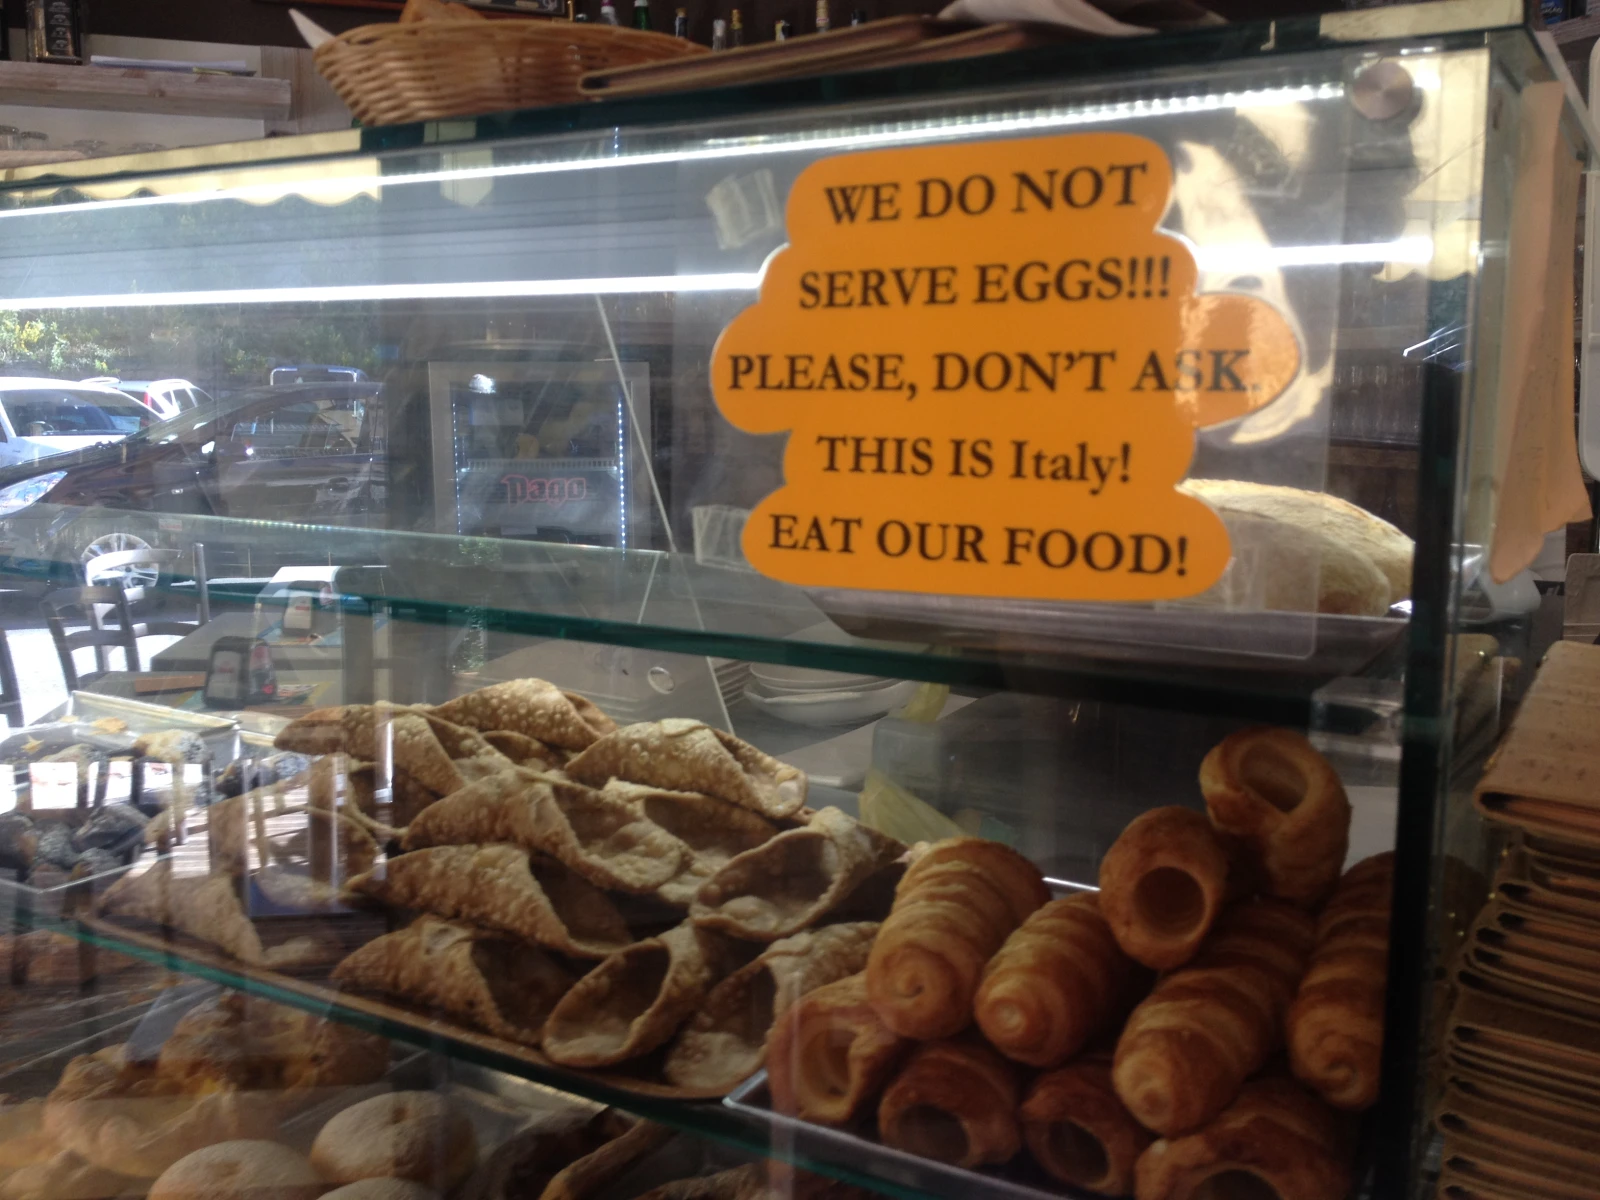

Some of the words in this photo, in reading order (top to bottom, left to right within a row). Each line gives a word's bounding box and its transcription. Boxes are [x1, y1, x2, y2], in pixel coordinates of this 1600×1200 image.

[824, 183, 900, 224] WE
[917, 175, 996, 219] DO
[1012, 162, 1148, 213] NOT
[799, 266, 957, 310] SERVE
[976, 256, 1171, 304] EGGS!!!
[729, 354, 918, 401] PLEASE,
[934, 351, 1116, 393] DON’T
[817, 436, 934, 476] THIS
[949, 440, 994, 479] IS
[1011, 441, 1131, 495] Italy!
[769, 514, 863, 554] EAT
[876, 520, 988, 564] OUR
[1003, 528, 1188, 577] FOOD!
